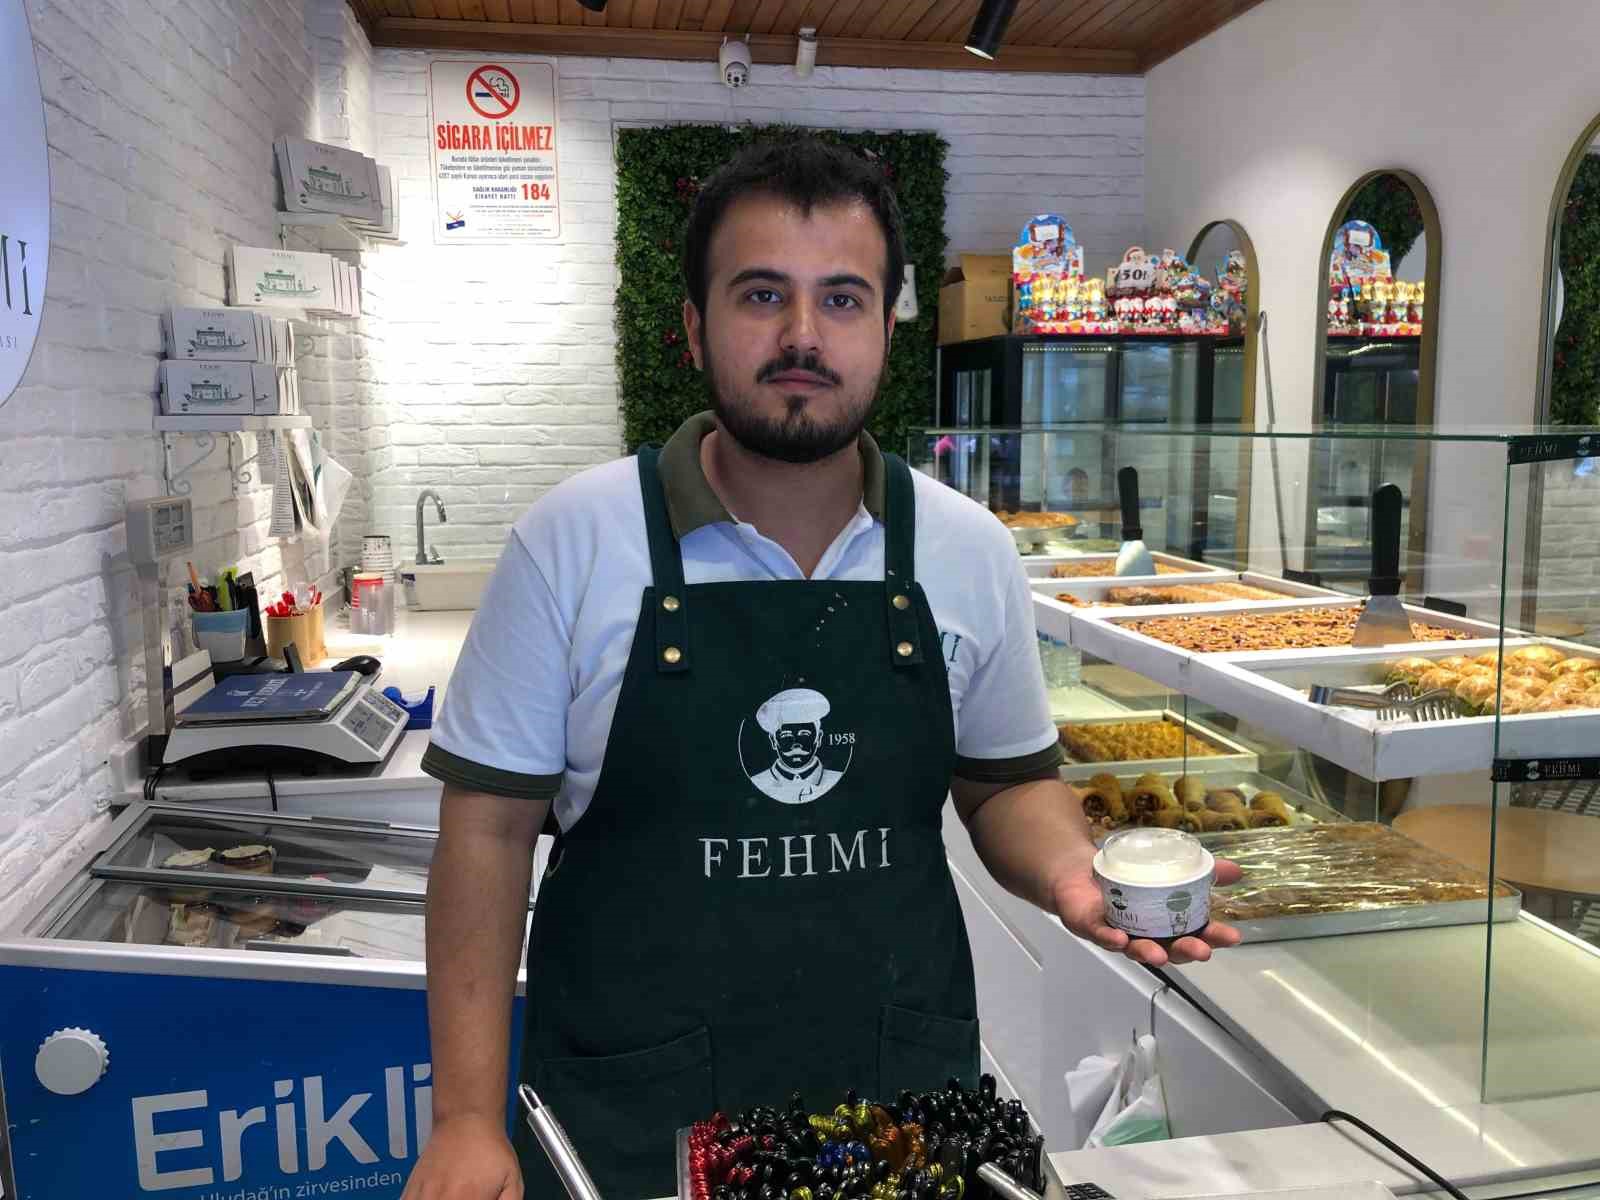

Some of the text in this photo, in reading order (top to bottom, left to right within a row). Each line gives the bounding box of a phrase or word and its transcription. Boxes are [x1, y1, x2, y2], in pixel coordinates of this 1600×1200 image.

[437, 121, 553, 154] SİGARA İÇİLMEZ
[521, 183, 550, 201] 184
[828, 732, 856, 746] 1958
[295, 1171, 402, 1198] zirvesinden
